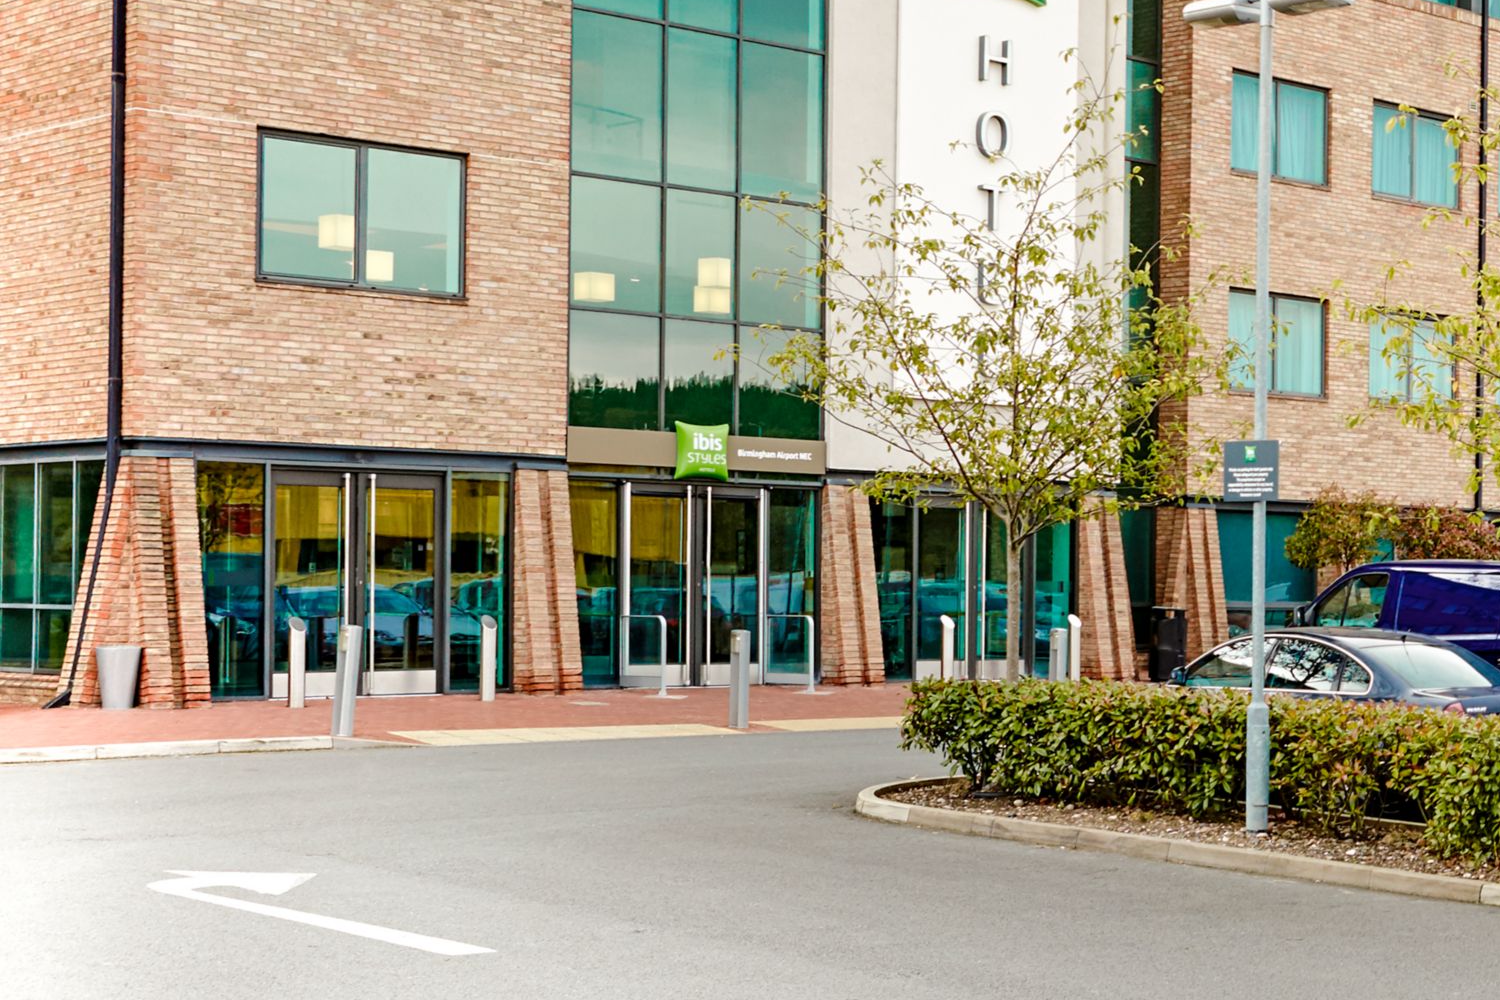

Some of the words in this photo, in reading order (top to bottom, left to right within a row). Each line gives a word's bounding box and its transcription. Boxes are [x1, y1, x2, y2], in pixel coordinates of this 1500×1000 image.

[693, 433, 723, 451] ibis
[737, 449, 776, 460] Birmingham
[777, 451, 799, 461] Airport
[800, 452, 812, 461] NEC
